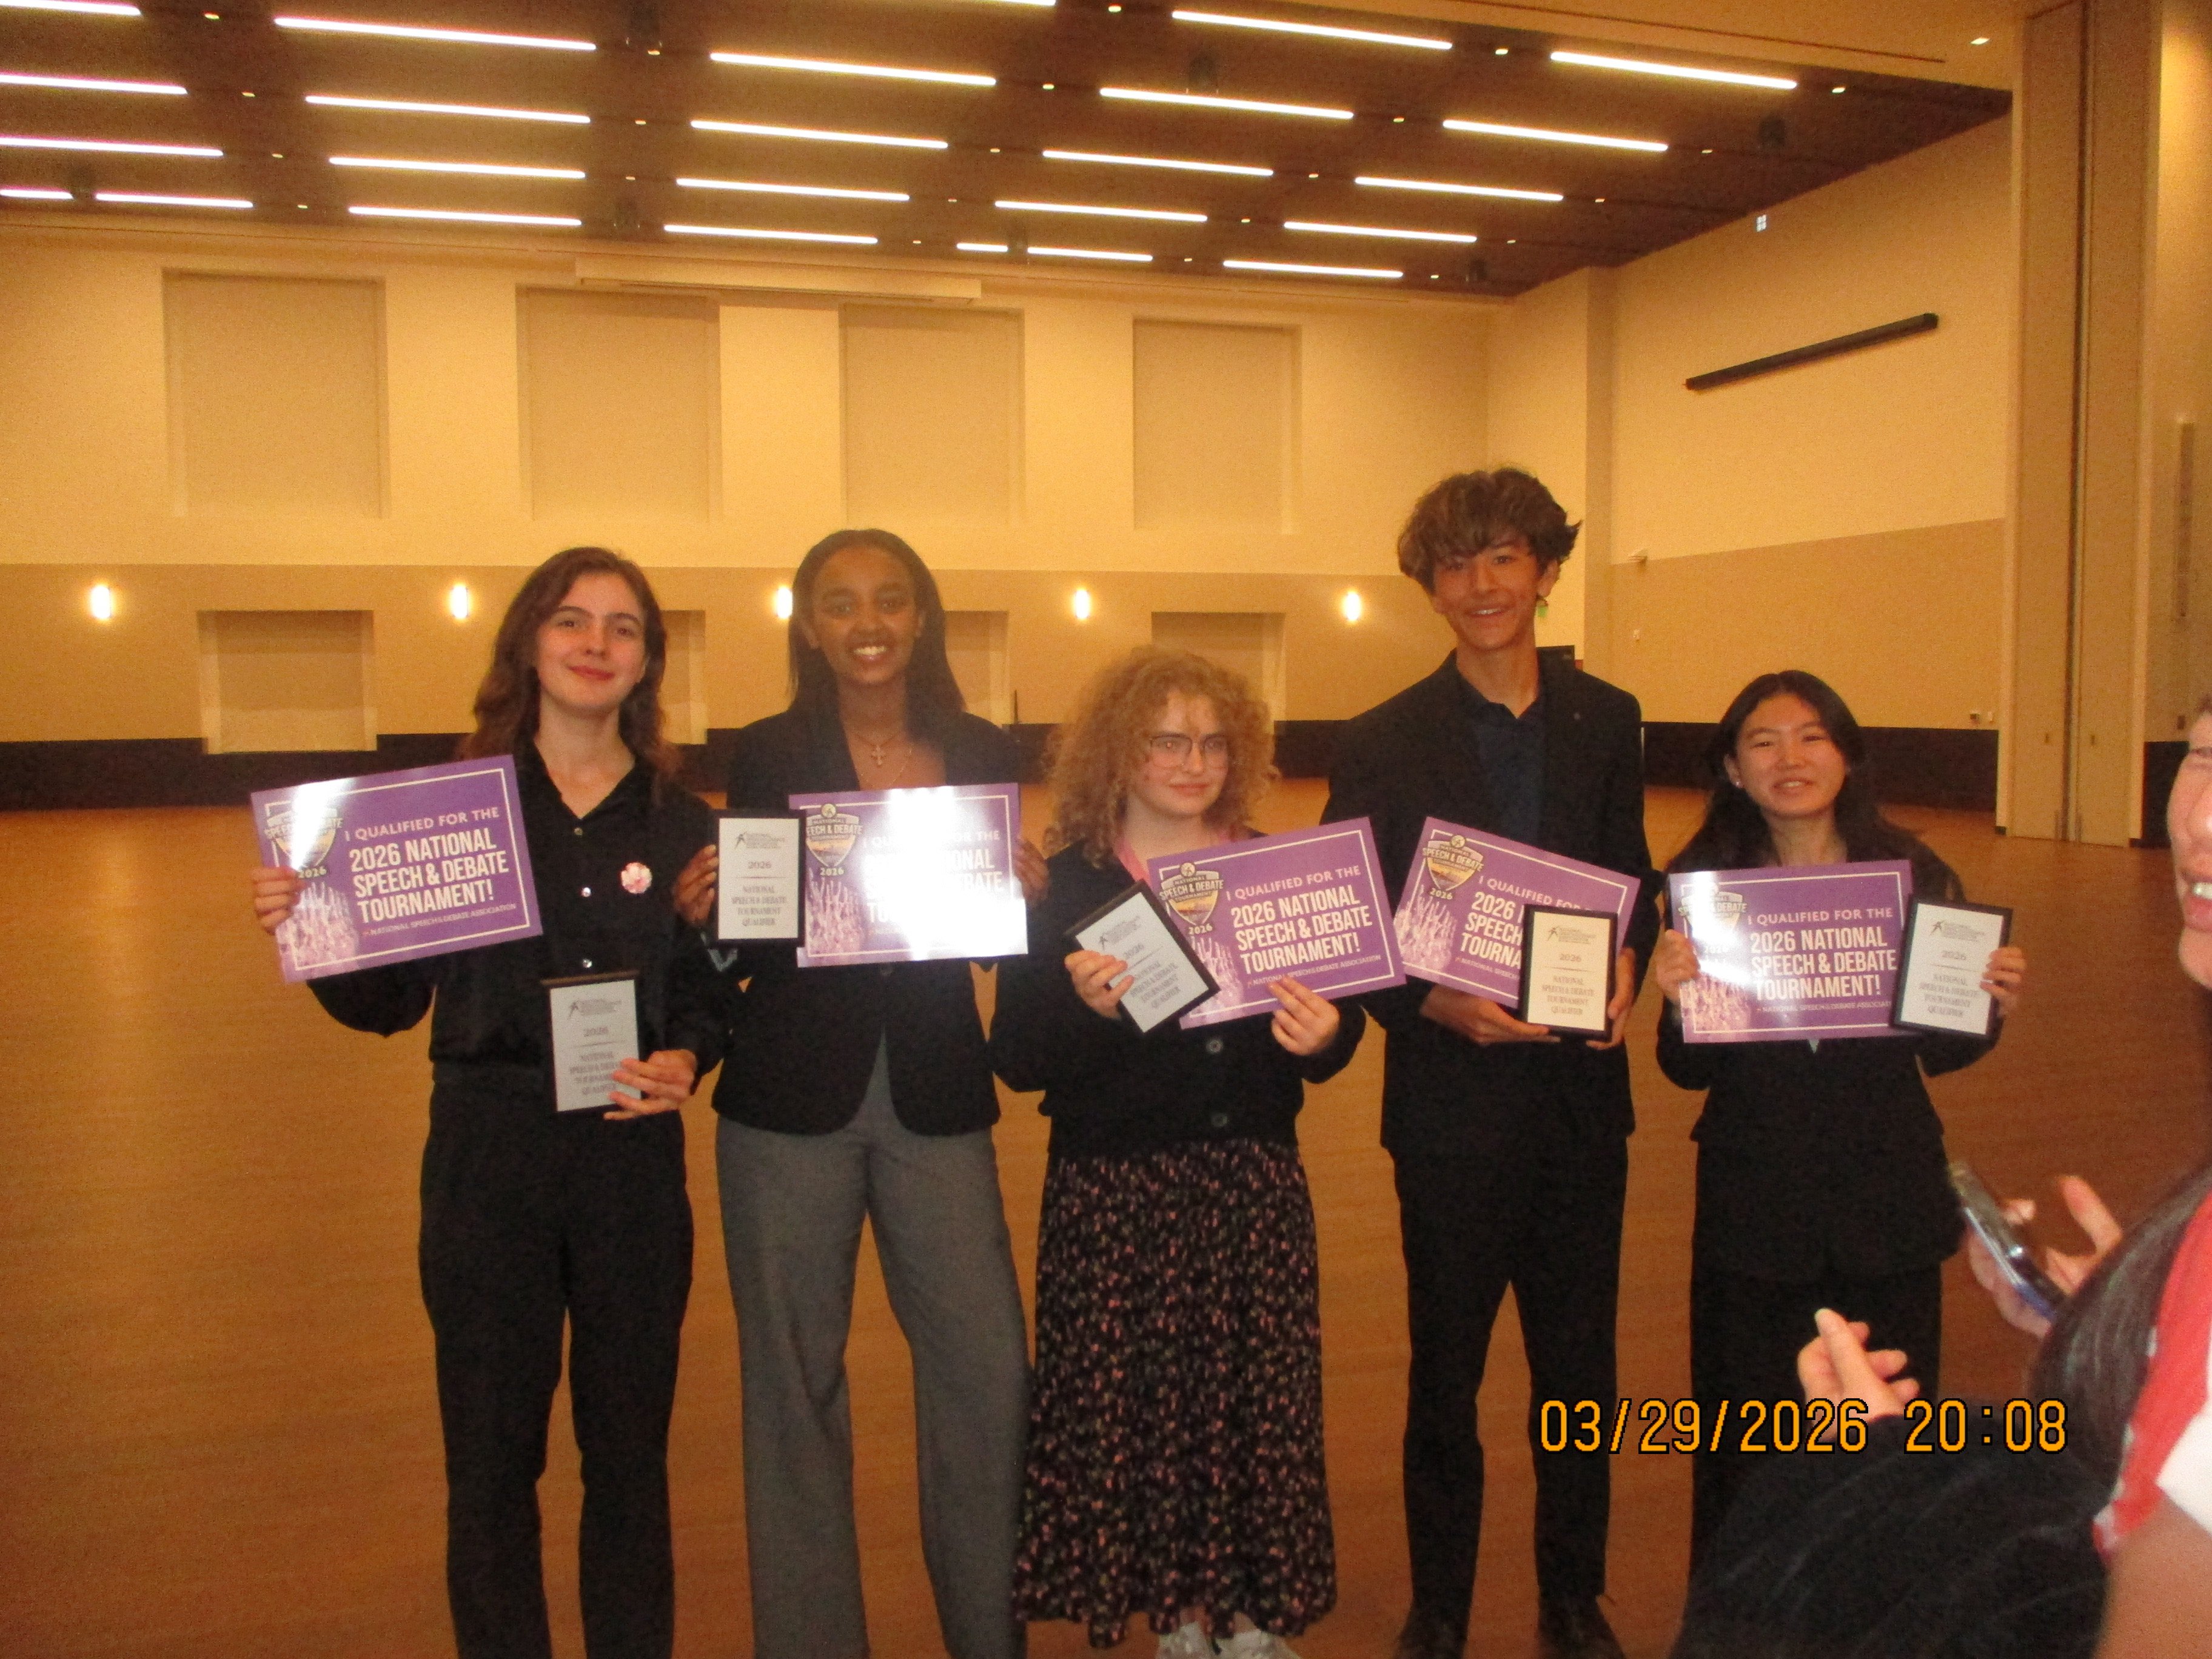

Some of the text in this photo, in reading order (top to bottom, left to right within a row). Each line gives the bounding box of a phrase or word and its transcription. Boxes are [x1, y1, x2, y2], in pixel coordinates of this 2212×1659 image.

[344, 807, 499, 842] I QUALIFIED FOR THE
[834, 823, 863, 835] DEBATE
[977, 830, 1000, 842] THE
[349, 828, 497, 872] 2026 NATIONAL
[1423, 848, 1450, 860] SPEECH
[1456, 855, 1484, 872] DEBATE
[353, 851, 509, 897] SPEECH & DEBATE
[820, 867, 845, 876] 2026
[1226, 865, 1361, 901] I QUALIFIED FOR THE
[357, 879, 494, 923] TOURNAMENT!
[1159, 883, 1188, 900] SPEECH
[1195, 879, 1224, 892] DEBATE
[1430, 887, 1453, 900] 2026
[1478, 875, 1484, 884] I
[1487, 878, 1552, 905] QUALIFIED
[1231, 884, 1360, 928] 2026 NATIONAL
[1472, 891, 1516, 920] 2026
[1716, 902, 1748, 913] DEBATE
[1748, 908, 1893, 926] I QUALIFIED FOR THE
[1188, 922, 1213, 936] 2026
[1235, 905, 1373, 951] SPEECH & DEBATE
[1465, 912, 1523, 946] SPEECH
[1751, 927, 1888, 954] 2026 NATIONAL
[1240, 932, 1361, 974] TOURNAMENT!
[1460, 933, 1522, 970] TOURNA
[1559, 953, 1582, 962] 2026
[1751, 950, 1897, 977] SPEECH & DEBATE
[1757, 974, 1881, 1000] TOURNAMENT!
